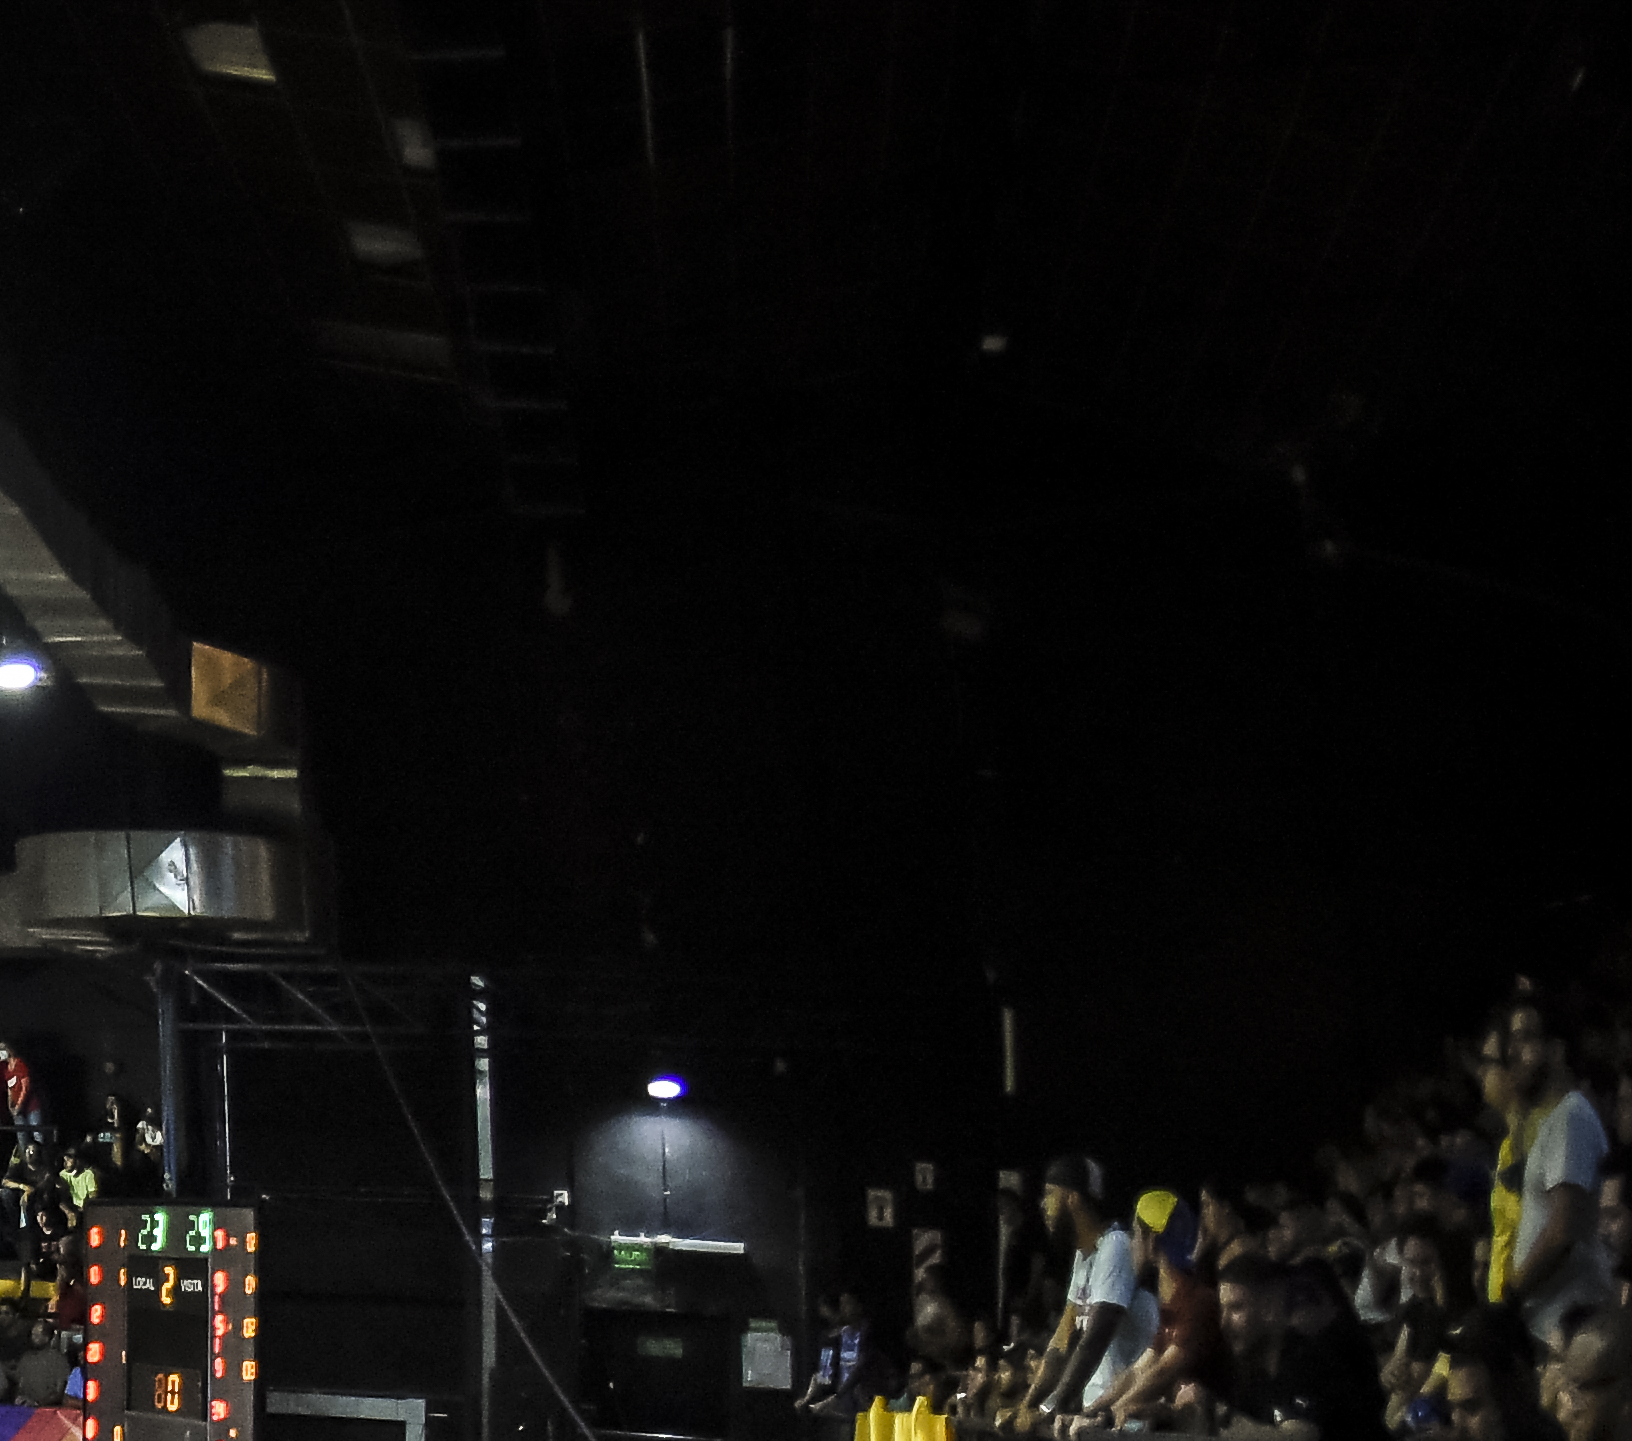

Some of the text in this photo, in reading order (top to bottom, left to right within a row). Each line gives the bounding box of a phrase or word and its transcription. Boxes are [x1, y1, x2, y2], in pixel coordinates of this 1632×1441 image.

[138, 1213, 212, 1252] 23 29
[132, 1277, 154, 1290] LOCAL
[160, 1266, 176, 1305] 2
[180, 1279, 202, 1292] VISITA
